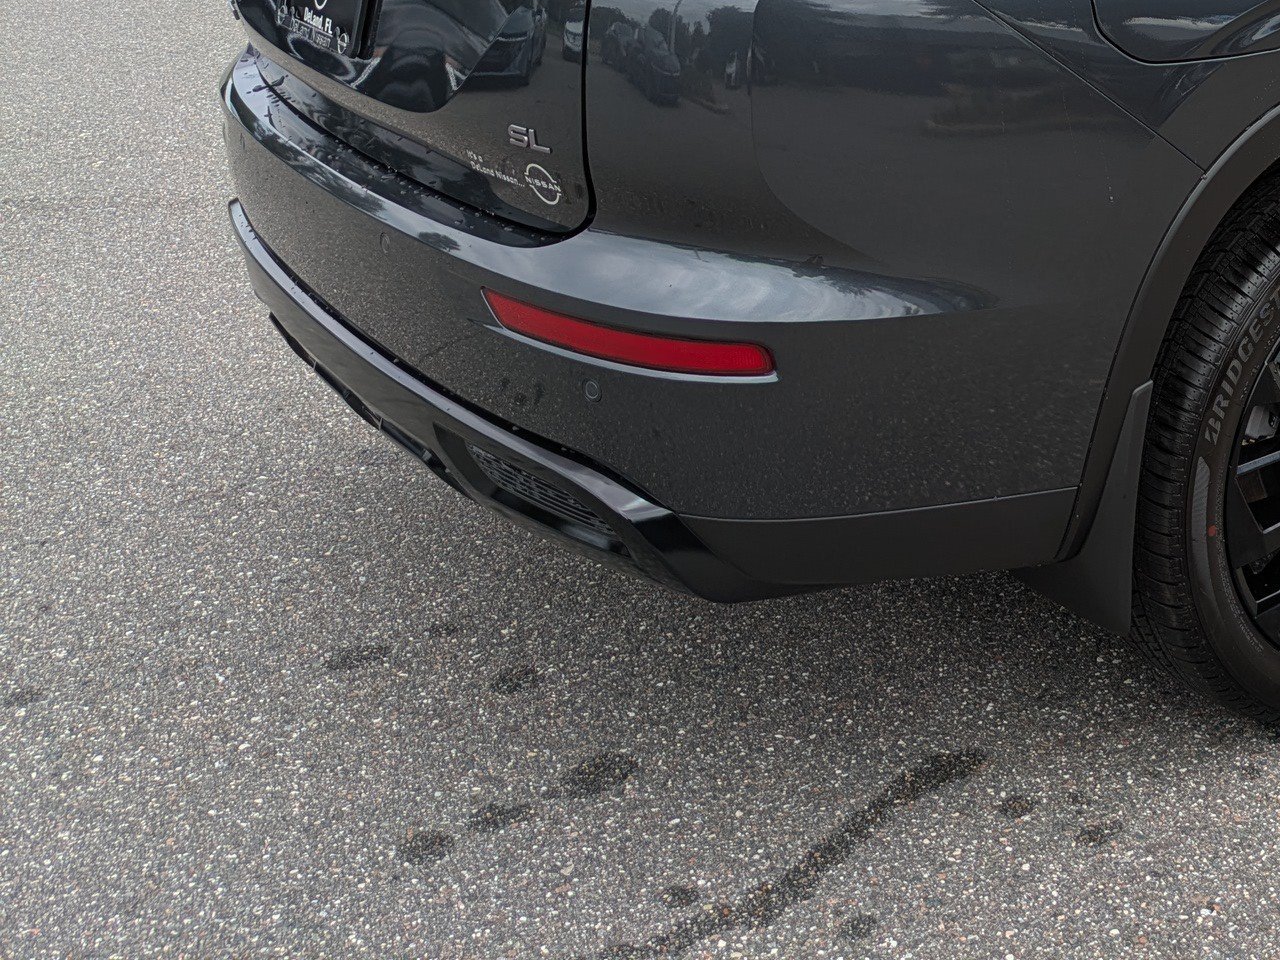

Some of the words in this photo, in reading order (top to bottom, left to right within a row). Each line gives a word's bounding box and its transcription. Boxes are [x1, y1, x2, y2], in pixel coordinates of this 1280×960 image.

[324, 17, 333, 35] FL
[507, 124, 552, 154] SL
[525, 175, 561, 192] NISSAN
